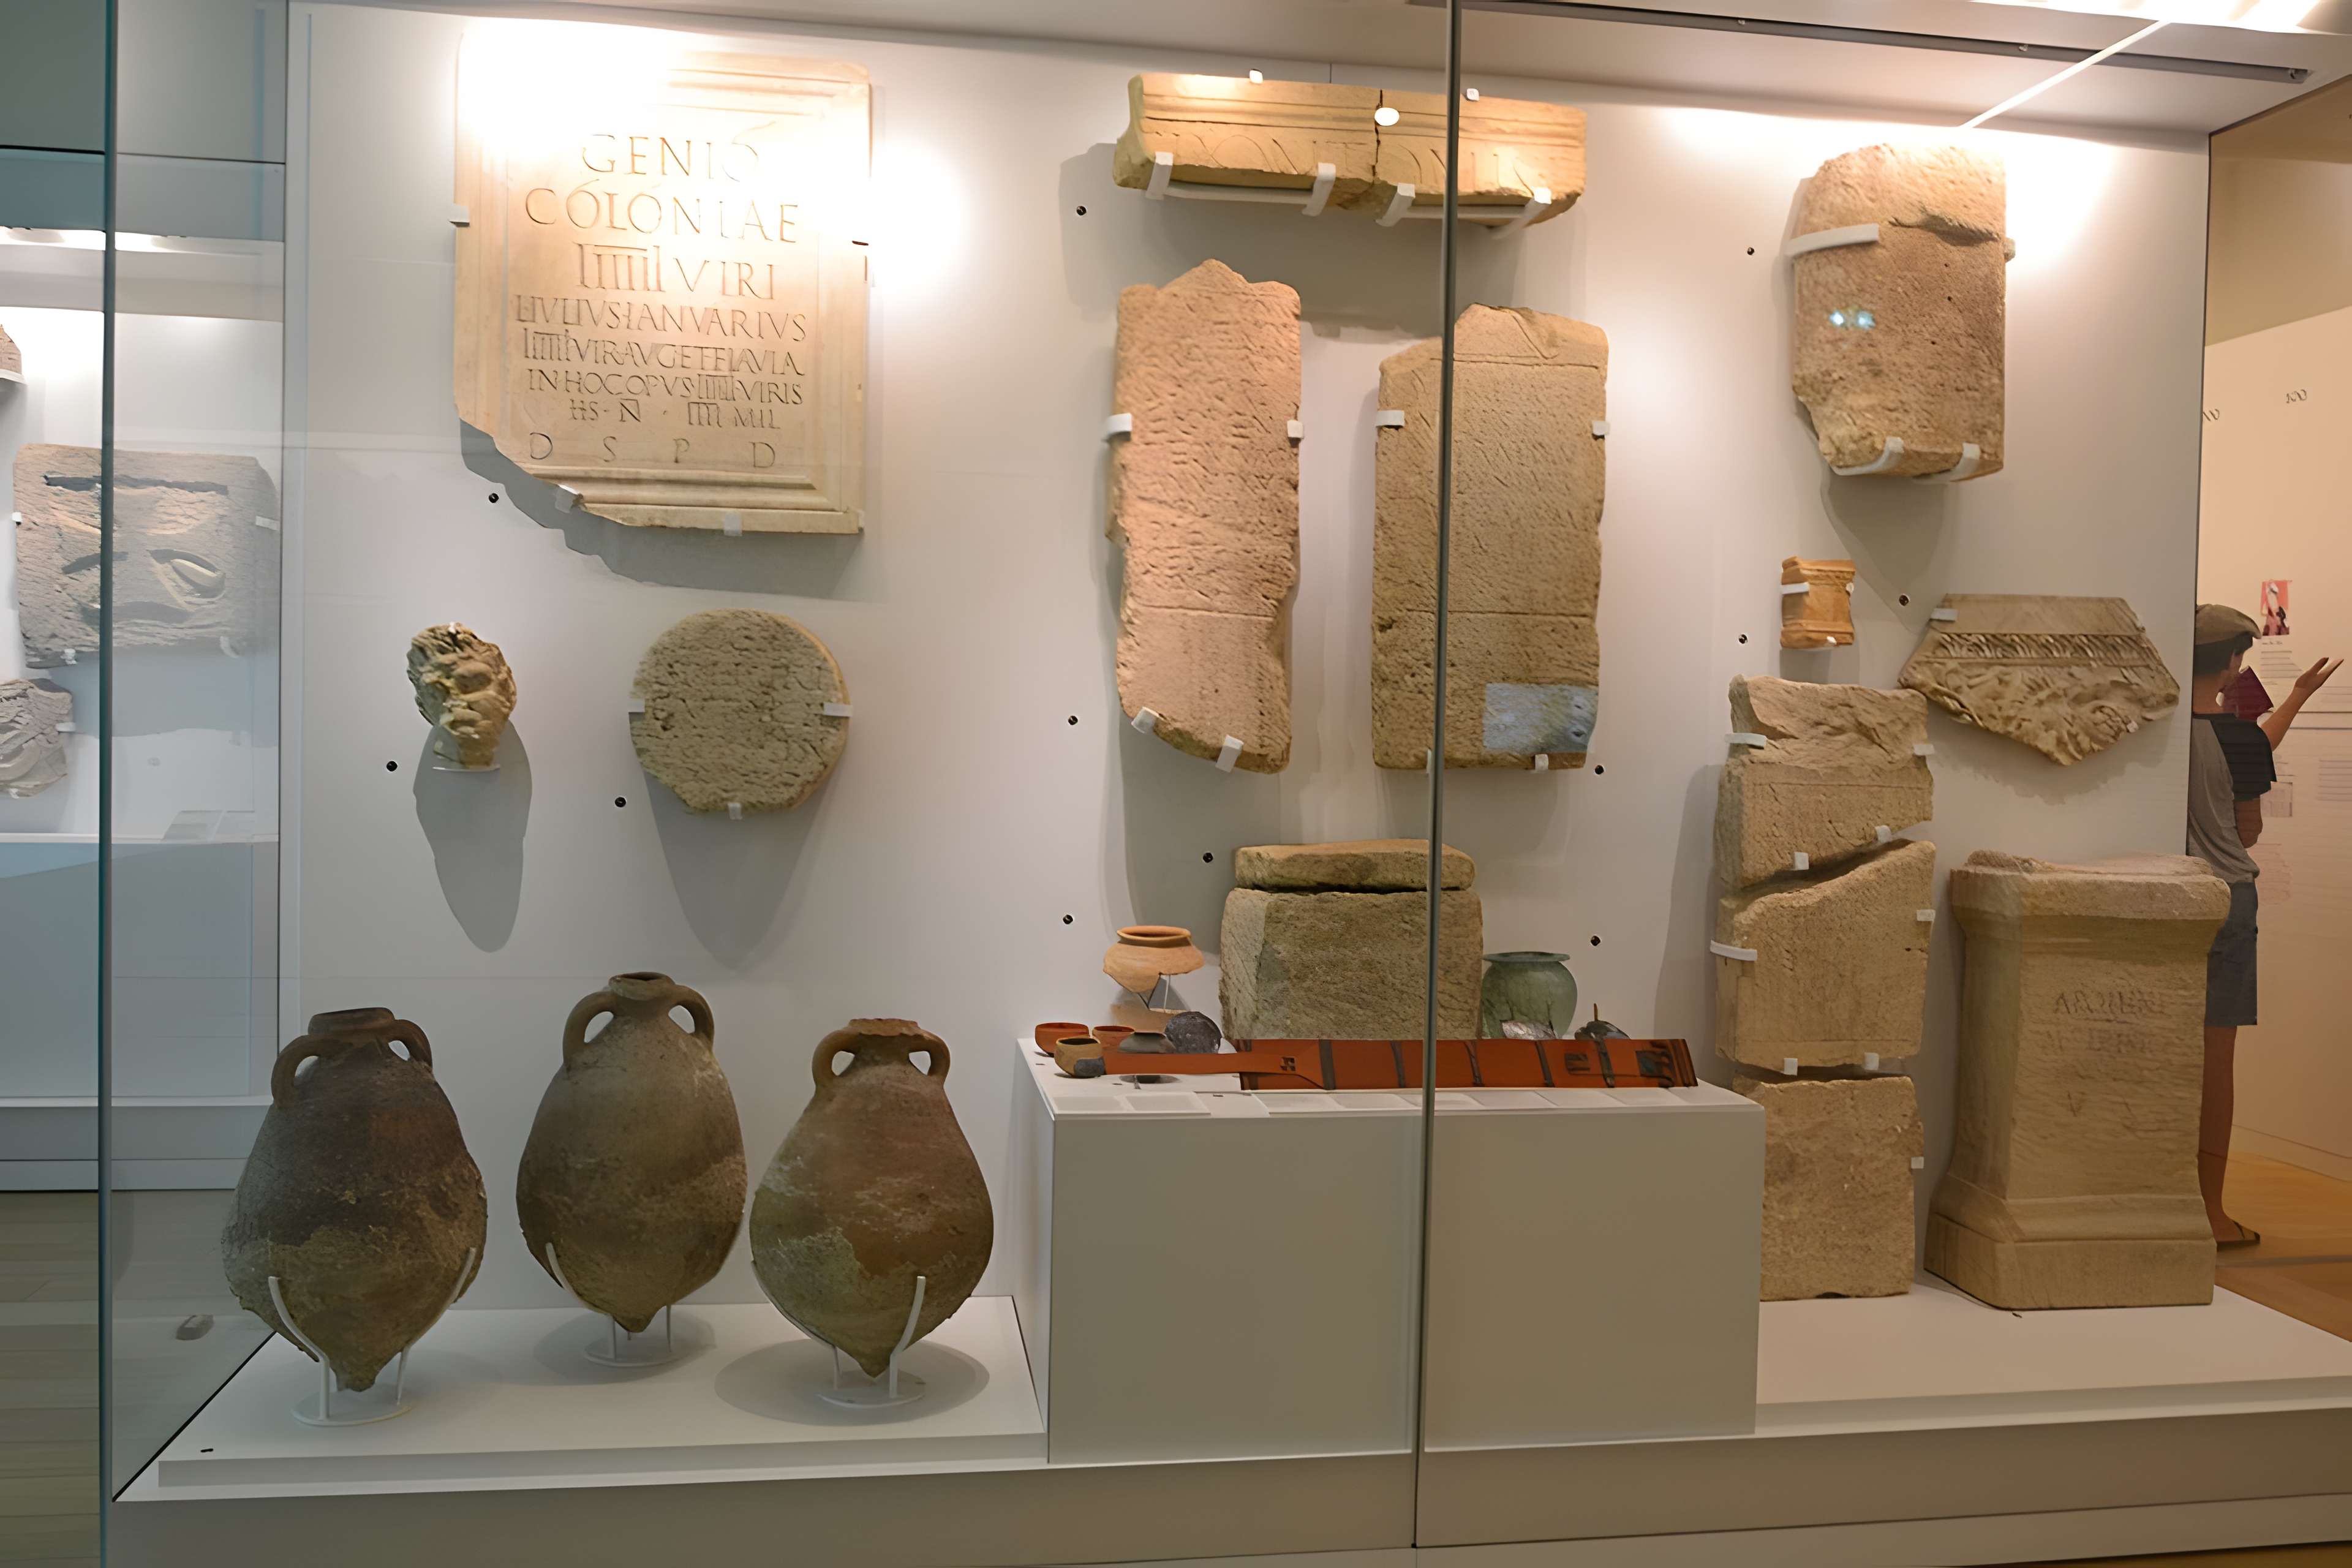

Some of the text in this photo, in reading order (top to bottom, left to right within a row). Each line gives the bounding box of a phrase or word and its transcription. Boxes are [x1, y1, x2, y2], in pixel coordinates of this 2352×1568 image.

[525, 185, 799, 243] COLONIAE
[529, 431, 776, 469] D S P D
